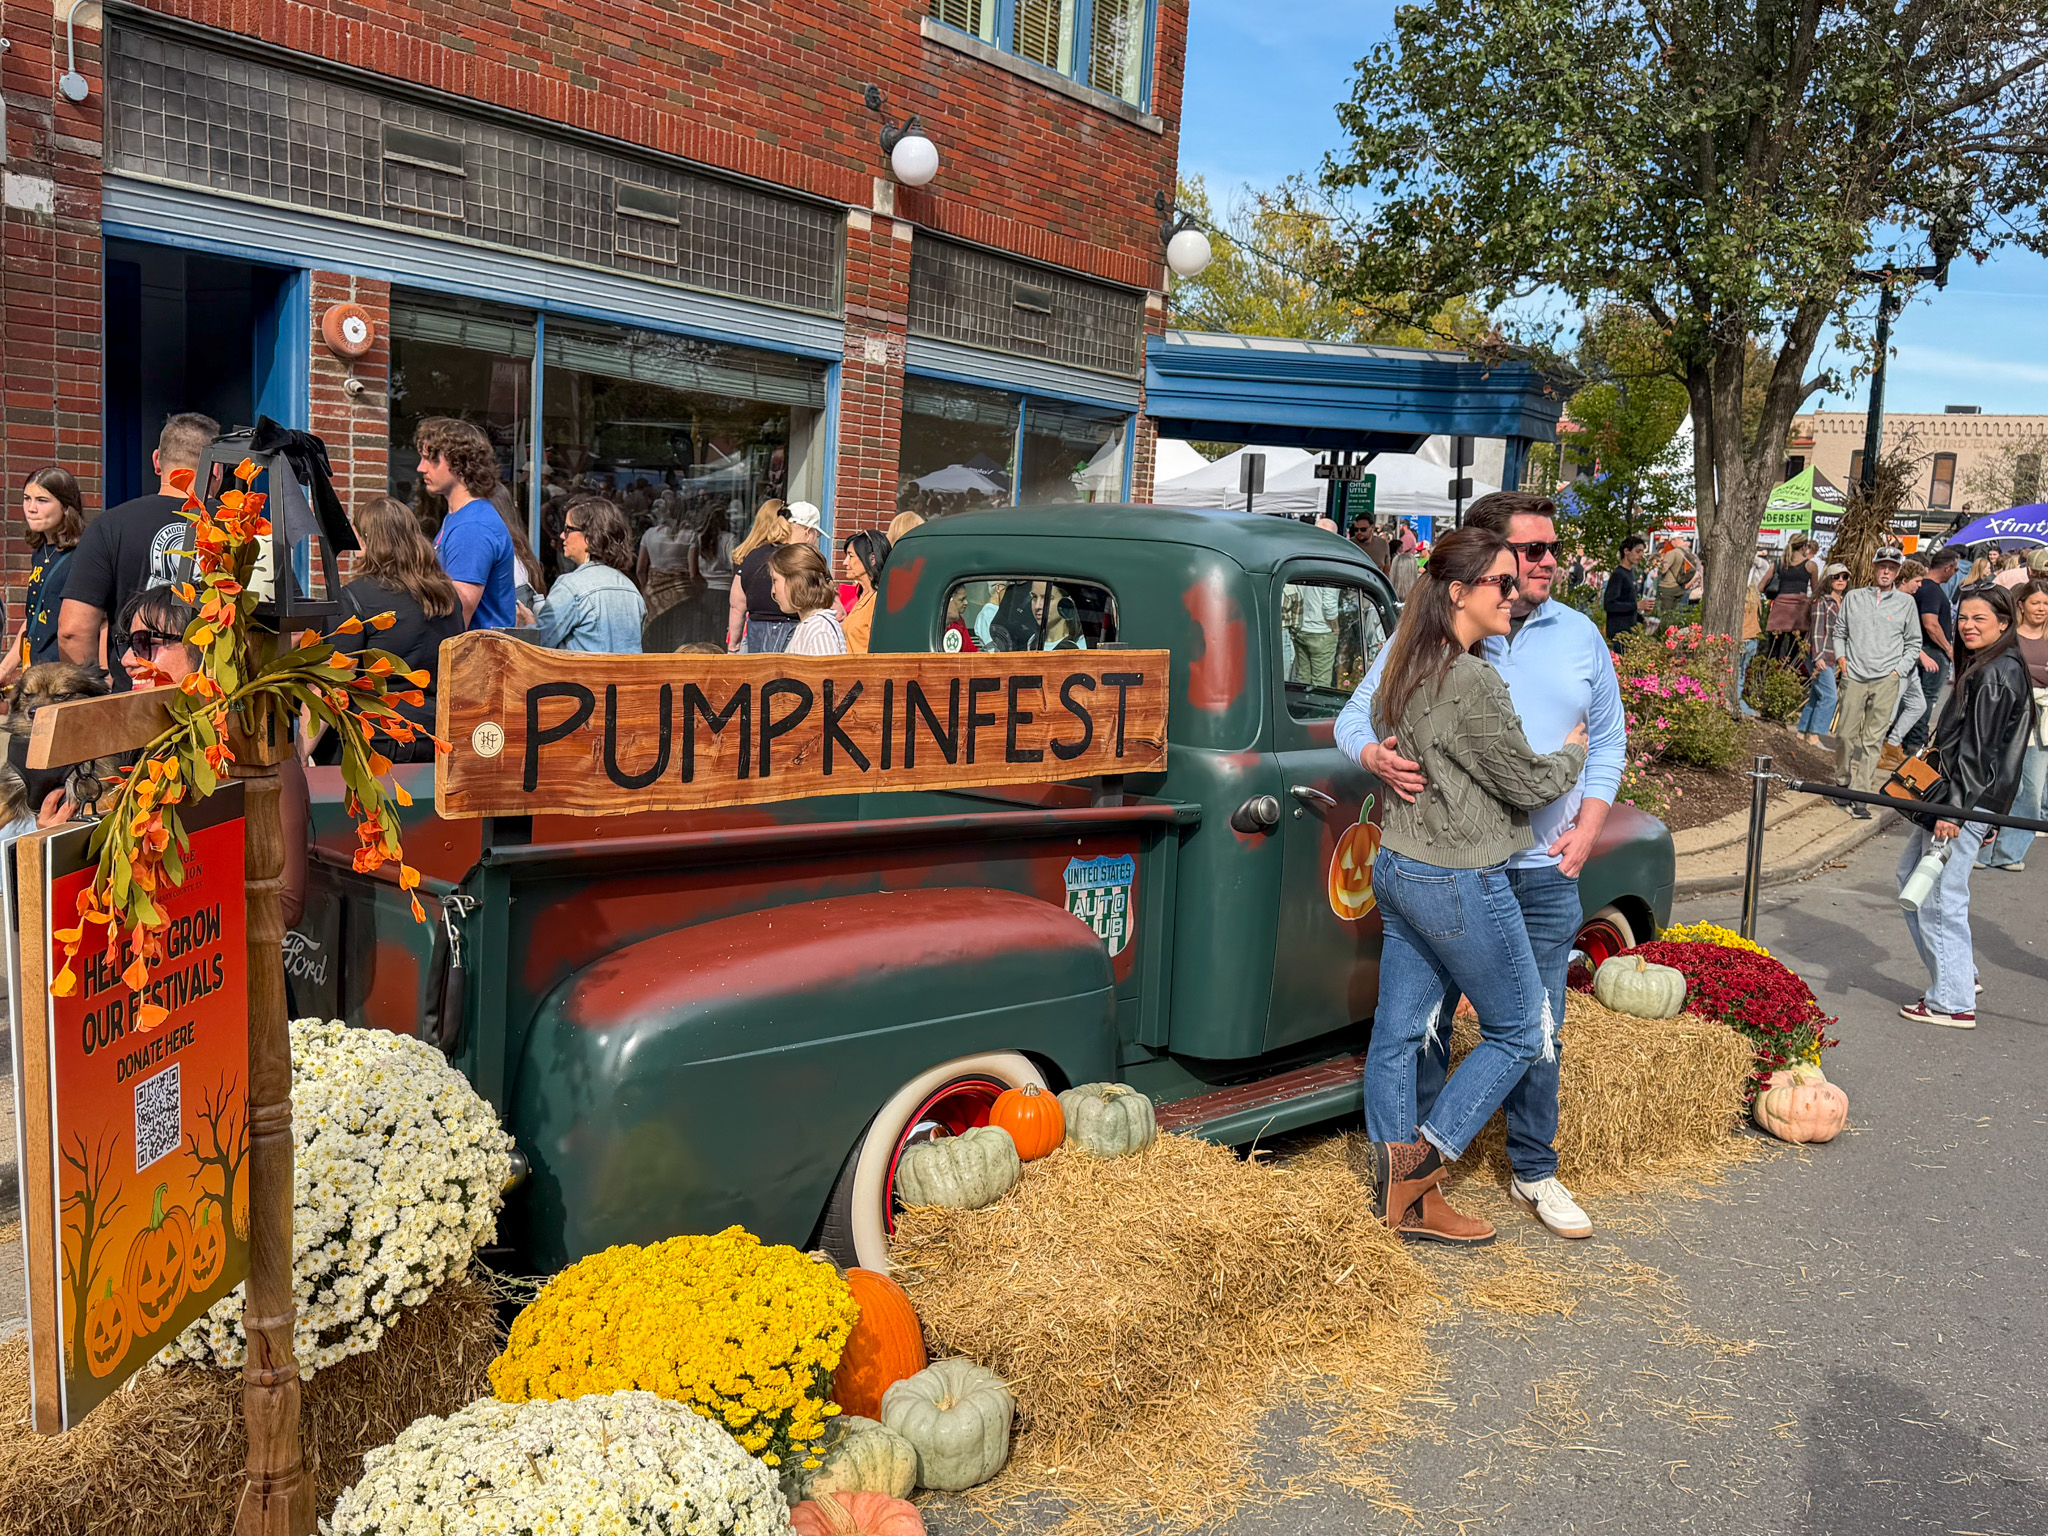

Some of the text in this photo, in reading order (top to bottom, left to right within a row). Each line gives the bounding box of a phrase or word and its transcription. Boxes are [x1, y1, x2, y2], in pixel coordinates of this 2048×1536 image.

[1329, 465, 1361, 480] ATM
[1763, 513, 1804, 523] DERSEN
[154, 533, 167, 552] LATE
[522, 672, 1145, 792] PUMPKINFEST
[1067, 863, 1131, 885] UNITED STATES
[1072, 893, 1126, 918] AUTO
[167, 902, 221, 959] GROW
[1097, 917, 1123, 938] UB
[281, 930, 328, 986] Ford
[82, 1000, 124, 1055] OUR
[117, 1020, 195, 1084] DONATE HERE
